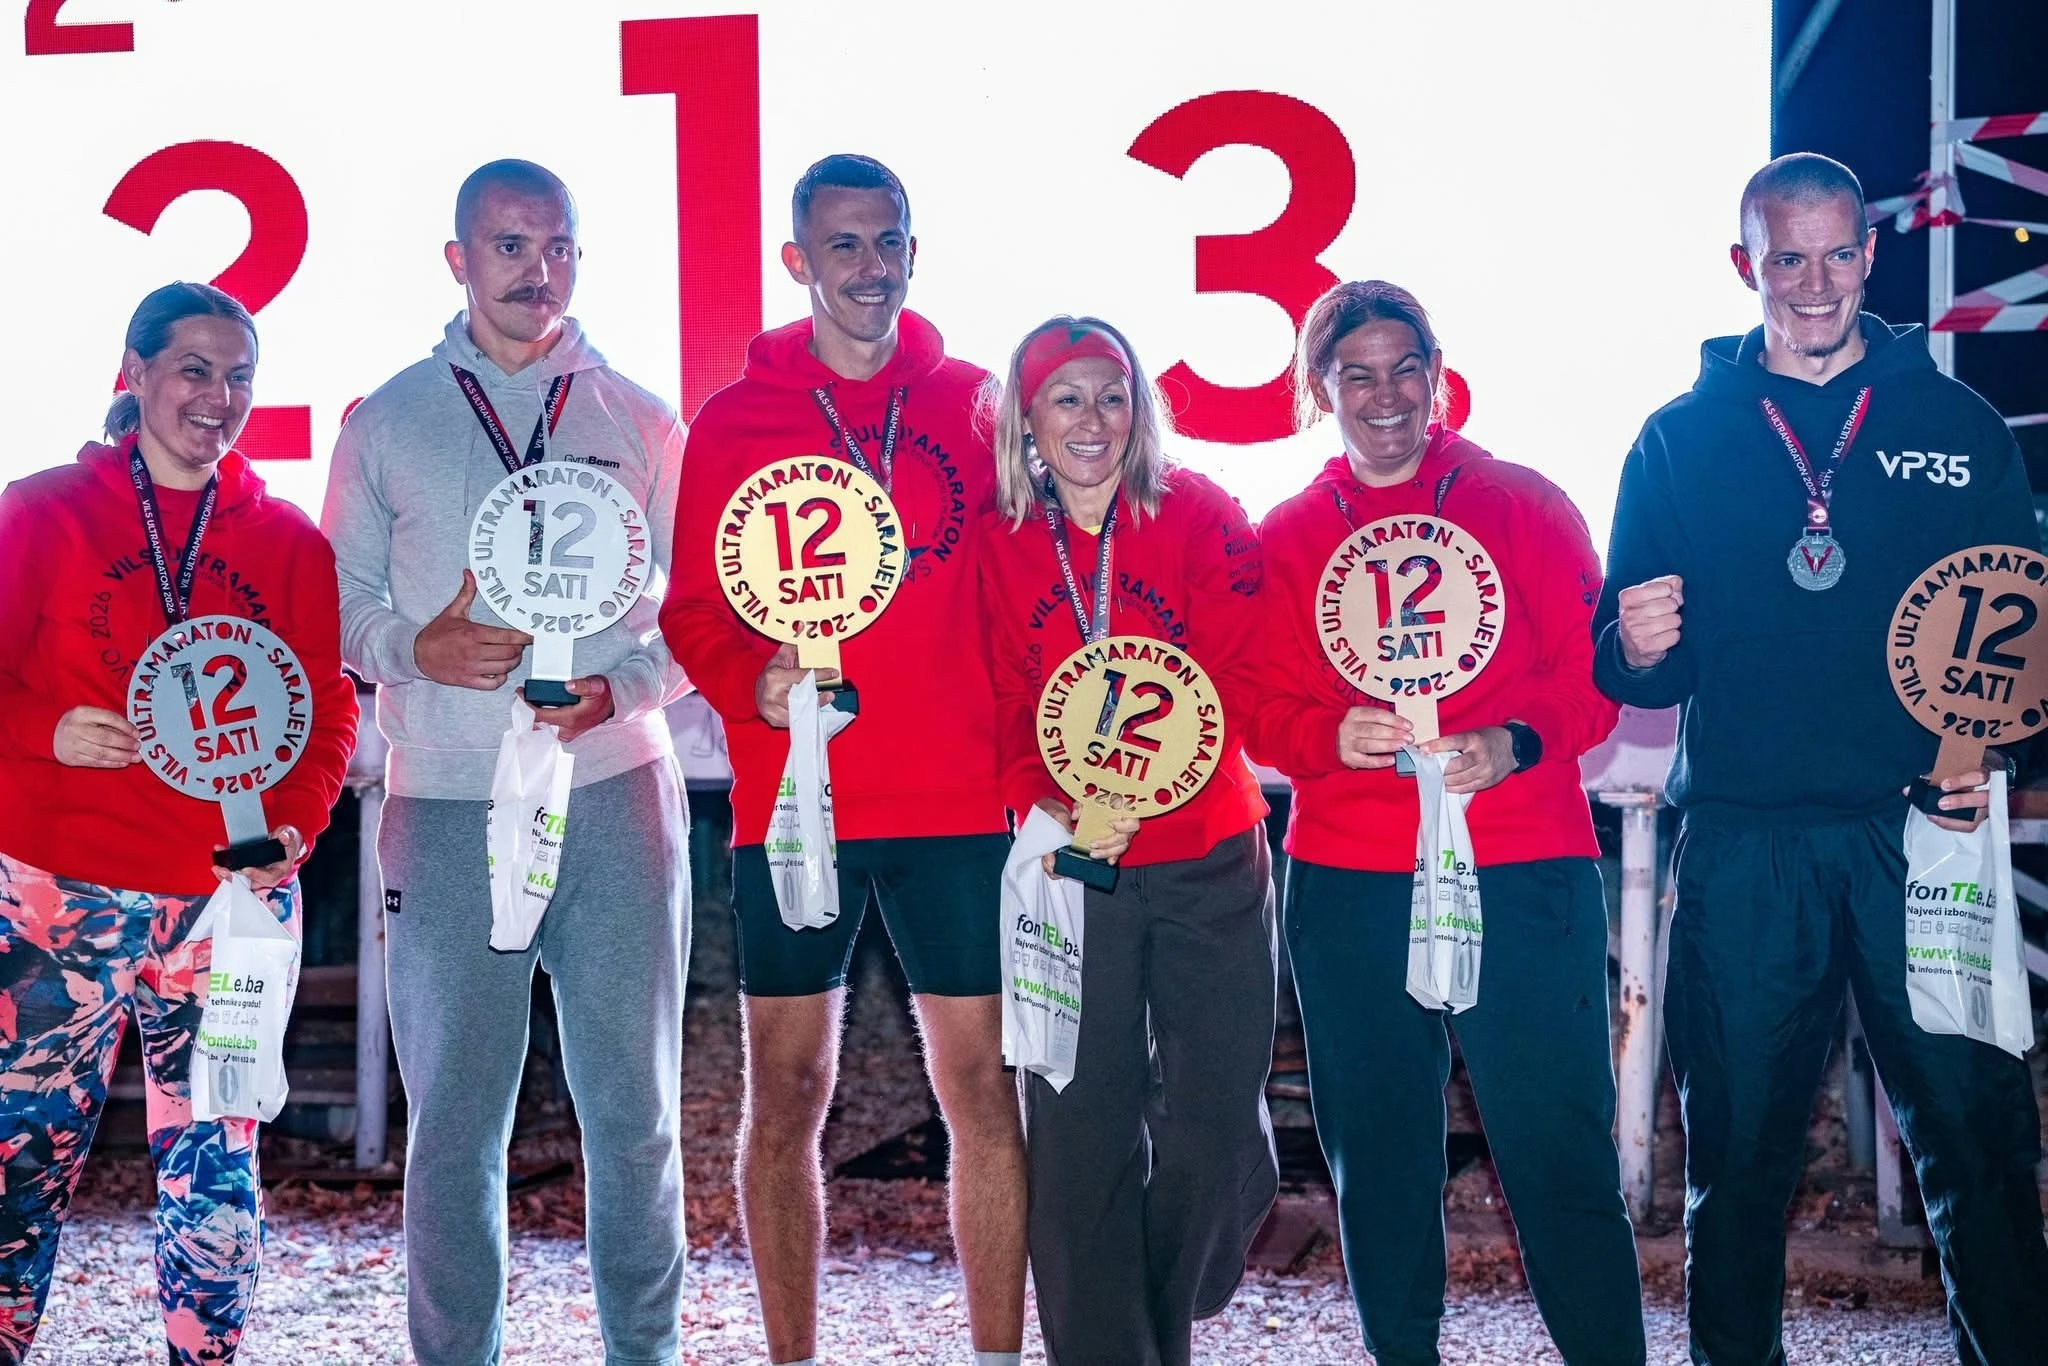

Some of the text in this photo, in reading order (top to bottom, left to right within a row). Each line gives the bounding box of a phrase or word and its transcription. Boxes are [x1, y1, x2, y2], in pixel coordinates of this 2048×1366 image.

[463, 377, 476, 395] VILS
[472, 394, 510, 455] ULTRAMARATON
[134, 458, 144, 471] WE
[564, 454, 621, 470] GymBeam
[1762, 397, 1818, 497] VILS ULTRAMARATON 2026
[1830, 440, 1845, 459] VILS
[132, 474, 144, 490] CITY
[1821, 468, 1835, 488] CITY
[523, 499, 597, 569] 12
[722, 462, 853, 576] ULTRAMARATON
[765, 496, 846, 571] 12
[1047, 511, 1057, 530] CITY
[104, 548, 154, 582] VILS
[142, 500, 176, 614] VILS ULTRAMARATON 2026
[179, 572, 191, 589] VILS
[185, 504, 213, 577] ULTRAMARATON
[475, 467, 646, 634] VILS ULTRAMARATON SARAJEVO 2026
[859, 495, 898, 613] SARAJEVO
[1055, 539, 1068, 560] VILS
[1101, 523, 1116, 596] ULTRAMARATON
[523, 571, 588, 600] SATI
[779, 573, 845, 605] SATI
[1061, 560, 1089, 633] ULTRAMARATON
[1322, 521, 1454, 633] ULTRAMARATON
[1365, 555, 1446, 629] 12
[731, 580, 770, 626] VILS
[791, 614, 848, 639] 2026
[1029, 583, 1068, 631] VILS
[1098, 596, 1108, 616] VILS
[1458, 554, 1499, 672] SARAJEVO
[1377, 631, 1443, 662] SATI
[1952, 584, 2038, 671] 12
[1330, 636, 1368, 682] VILS
[134, 621, 306, 795] VILS ULTRAMARATON SARAJEVO 2026
[170, 654, 257, 731] 12
[1390, 672, 1447, 697] 2026
[1895, 655, 1926, 706] VILS
[1941, 712, 2002, 738] 2026
[1940, 666, 2015, 704] SATI
[1043, 642, 1219, 813] VILS ULTRAMARATON SARAJEVO 2026
[1095, 668, 1174, 753] 12
[194, 726, 260, 763] SATI
[1083, 741, 1151, 782] SATI
[539, 838, 558, 848] zbor
[1907, 905, 1942, 917] Najveći
[1944, 907, 1968, 919] izbor
